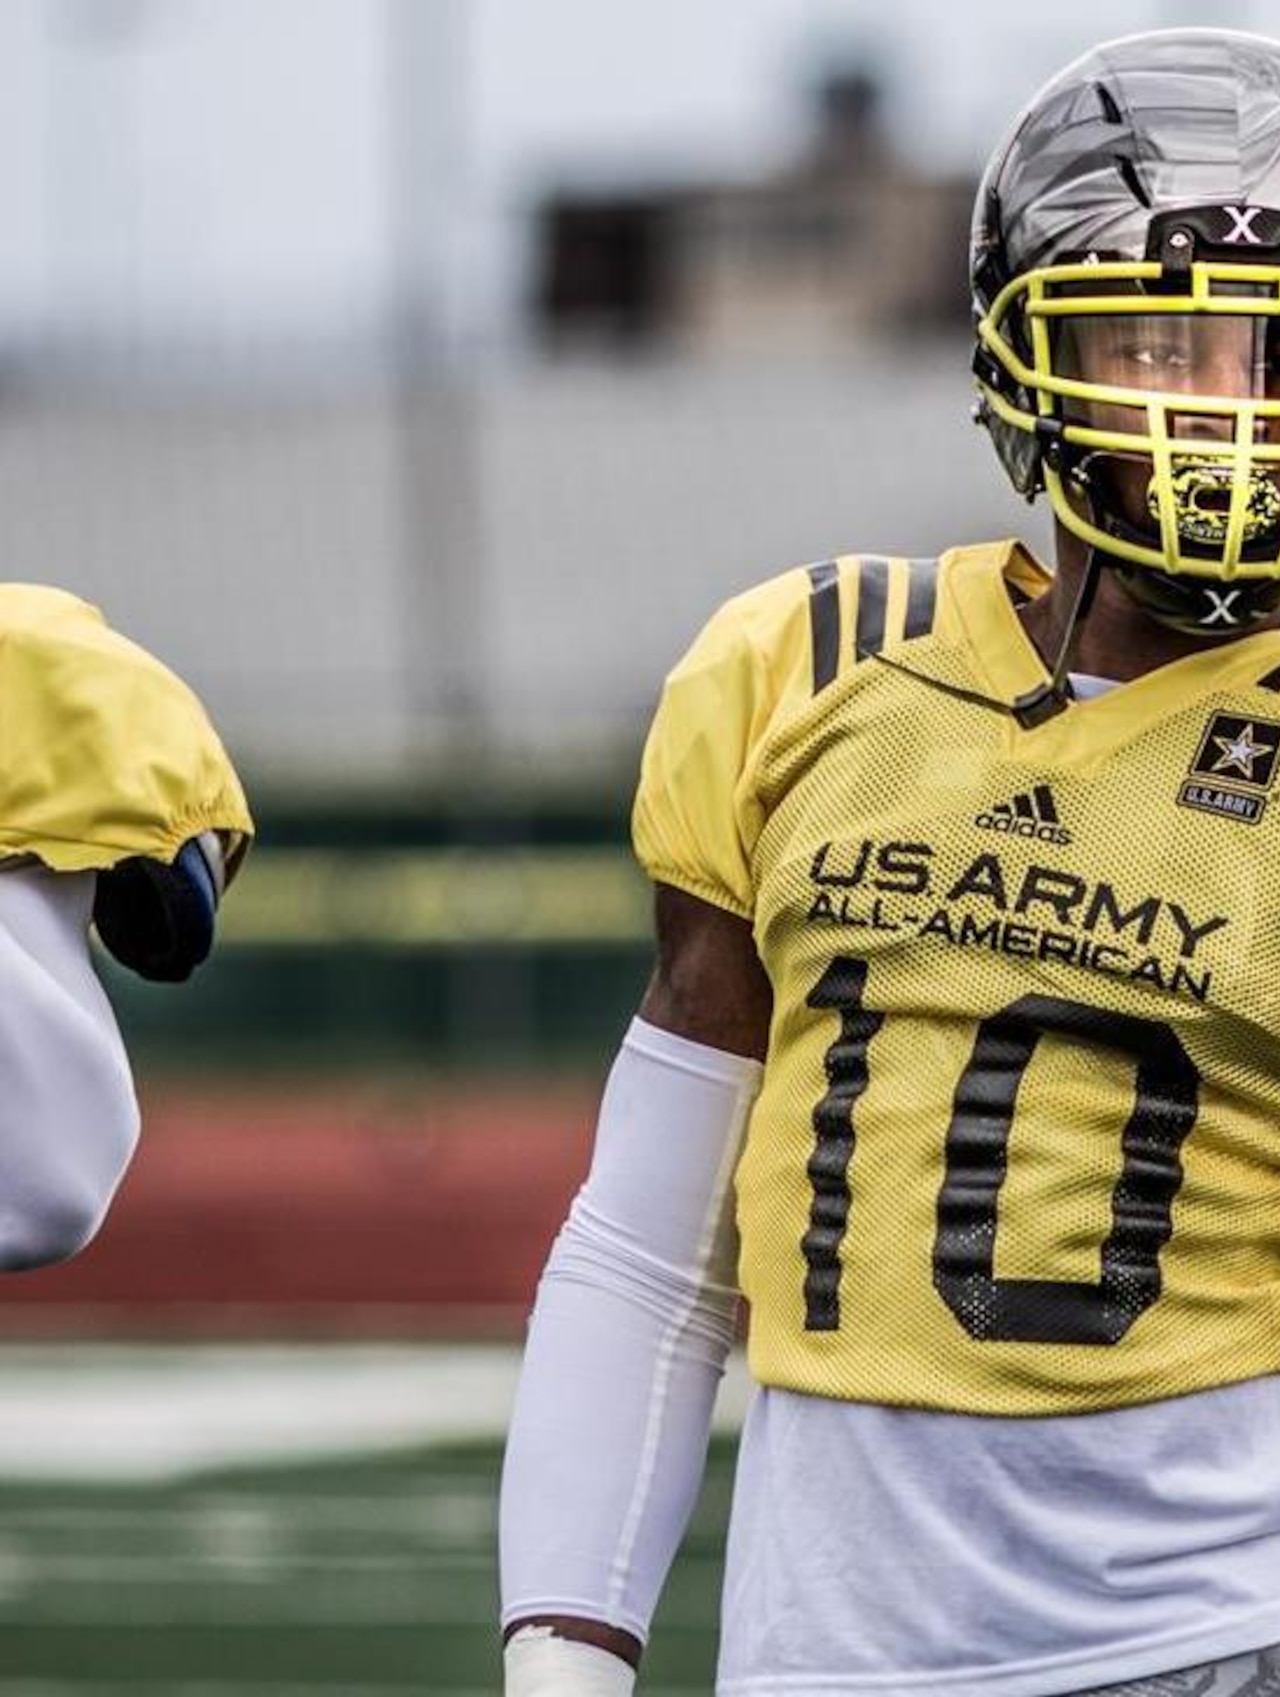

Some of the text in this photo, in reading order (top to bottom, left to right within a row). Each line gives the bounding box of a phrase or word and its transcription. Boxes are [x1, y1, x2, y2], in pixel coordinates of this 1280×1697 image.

[1222, 206, 1263, 243] X
[1199, 588, 1241, 624] X
[975, 811, 1072, 845] adidas
[945, 851, 1229, 959] ARMY
[805, 893, 1213, 1001] ALL-AMERICAN
[801, 955, 1201, 1346] 10
